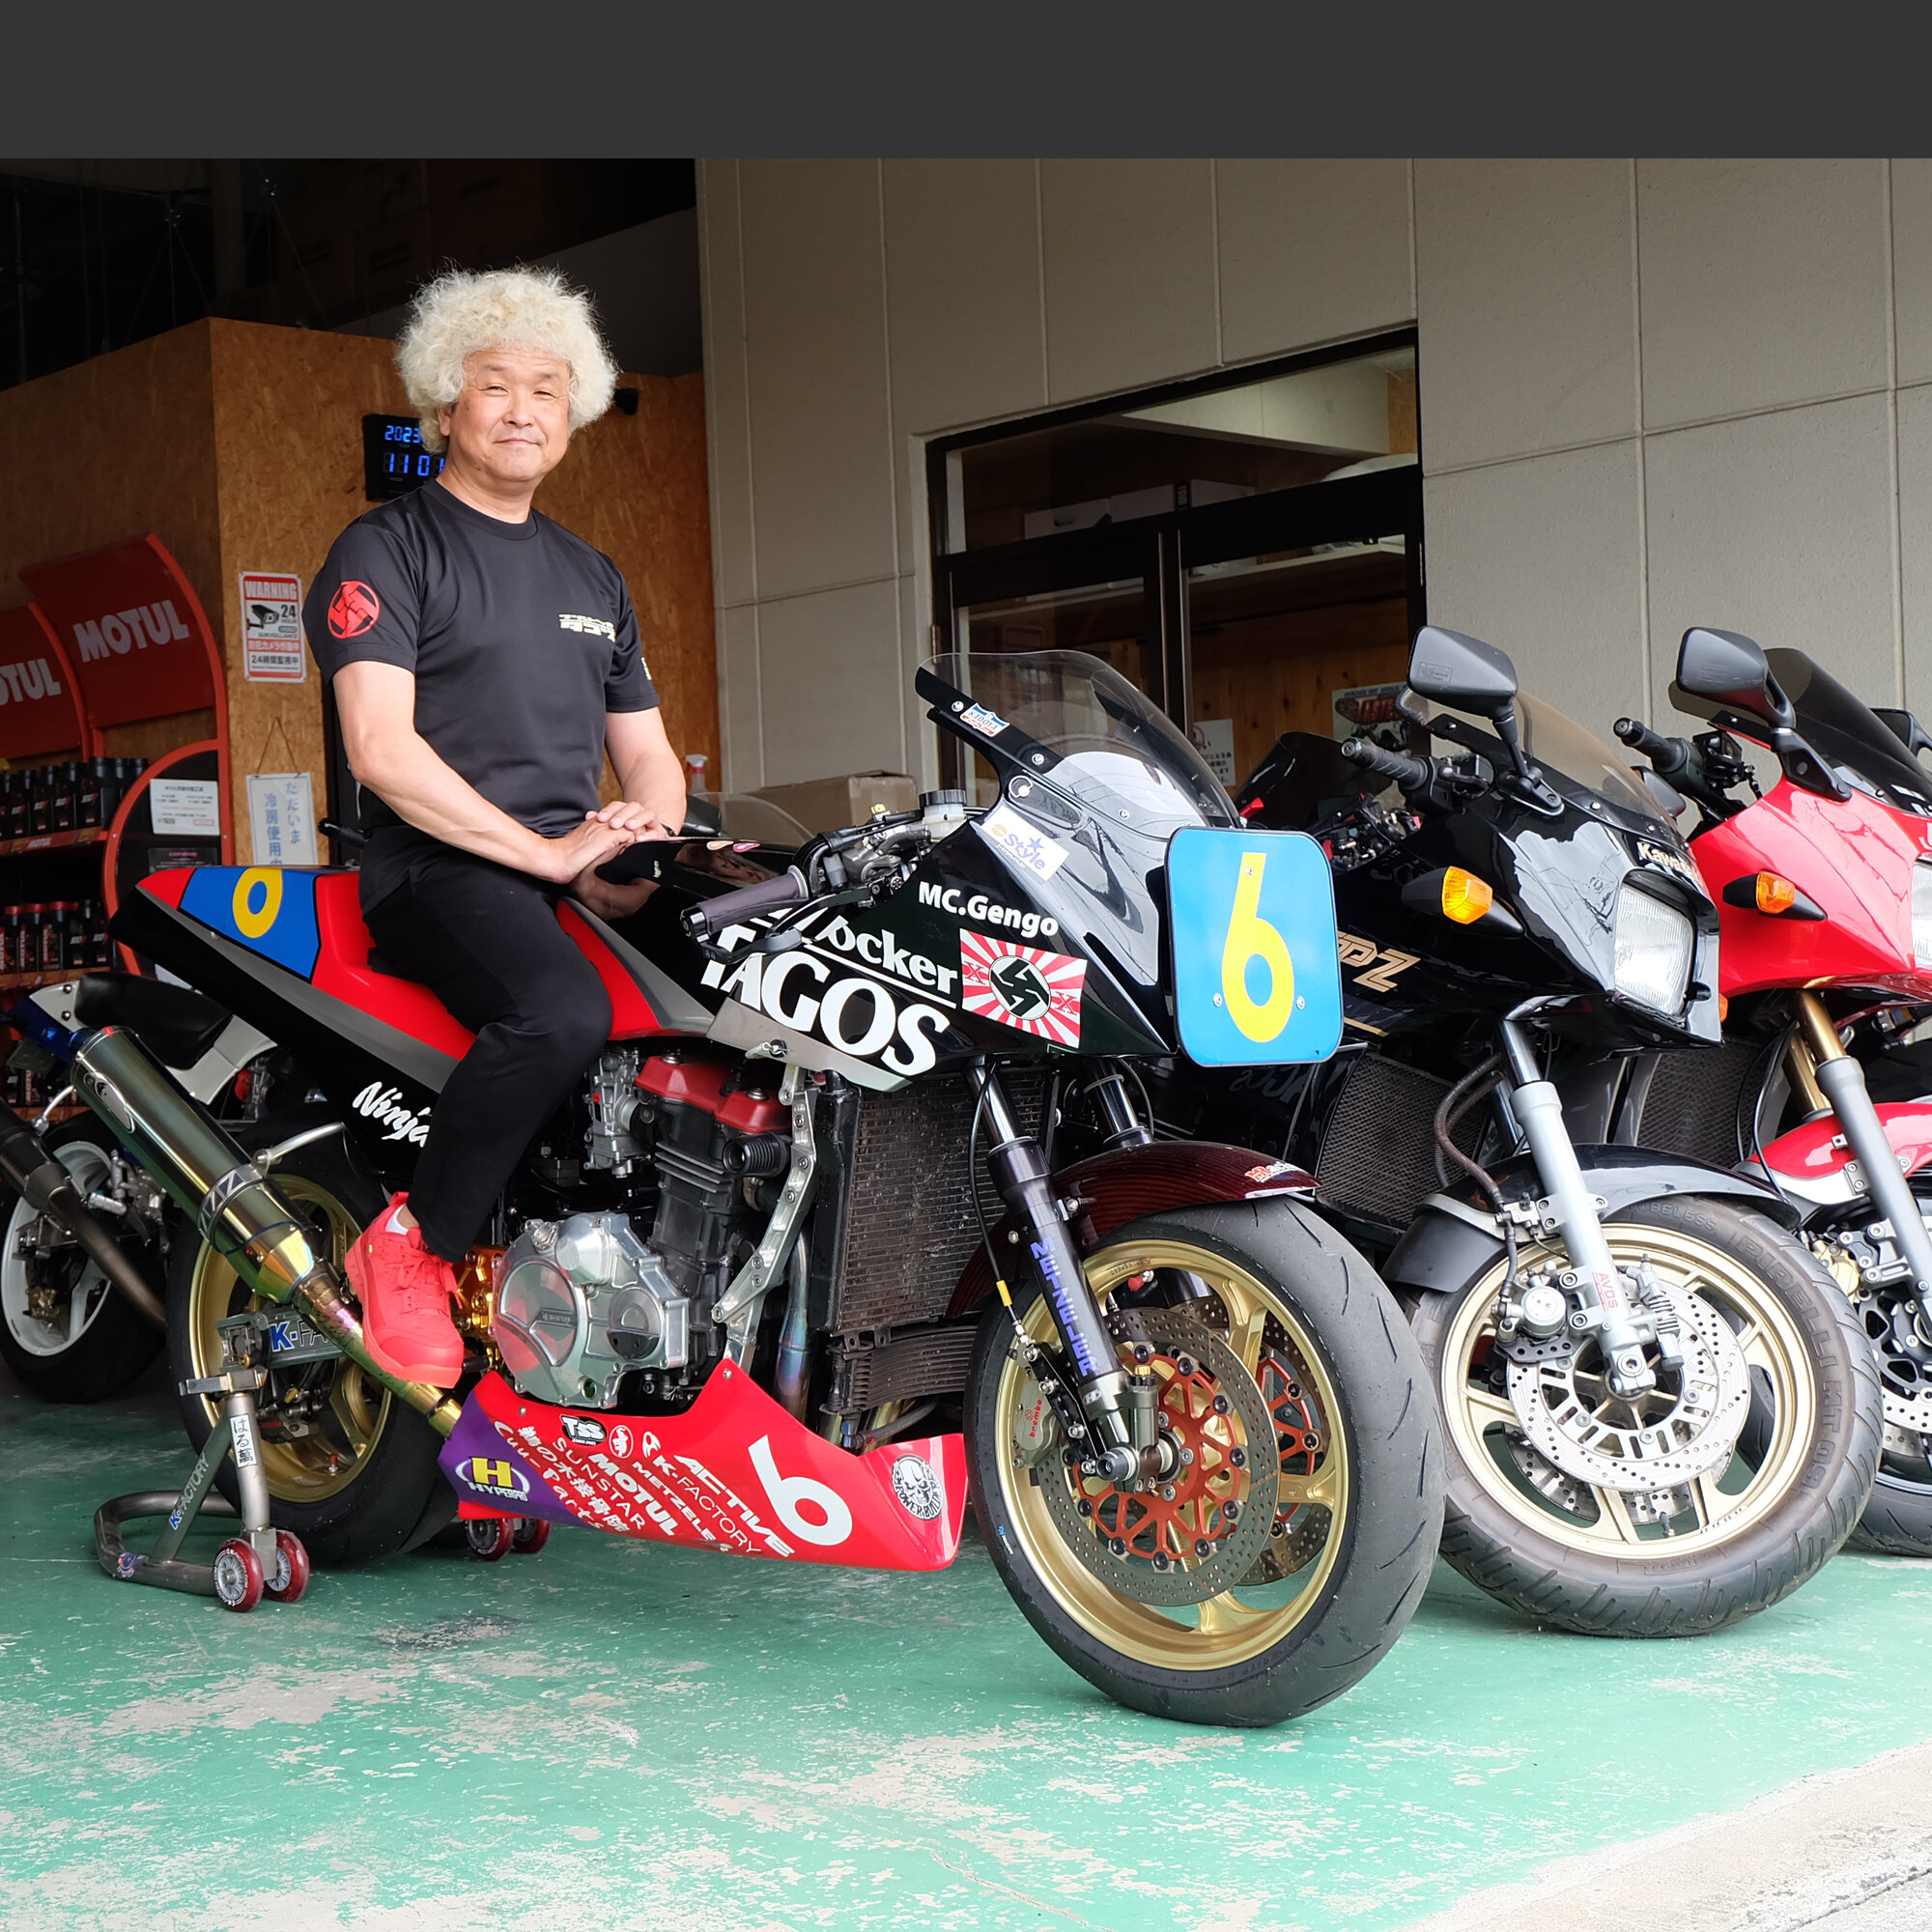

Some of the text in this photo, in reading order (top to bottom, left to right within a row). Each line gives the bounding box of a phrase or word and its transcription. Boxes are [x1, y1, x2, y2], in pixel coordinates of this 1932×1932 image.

[384, 425, 422, 443] 2023
[244, 581, 298, 600] WARNING
[281, 604, 297, 618] 24
[72, 600, 190, 663] MOTUL
[285, 782, 301, 844] ただいま
[1004, 833, 1046, 869] Style
[918, 880, 1060, 939] MC.Gengo
[1221, 852, 1295, 1042] 6
[352, 1081, 432, 1149] Ninja
[1029, 1236, 1099, 1378] METZELER
[1739, 1235, 1840, 1369] PIRELLI
[270, 1319, 328, 1352] K-FA
[1028, 1399, 1043, 1438] brembo
[467, 1481, 529, 1502] HYPERPRO
[469, 1456, 515, 1490] H
[552, 1436, 646, 1530] SUNSTAR
[587, 1452, 679, 1536] MOTUL
[748, 1434, 854, 1547] 6
[672, 1454, 796, 1558] ACTIVE
